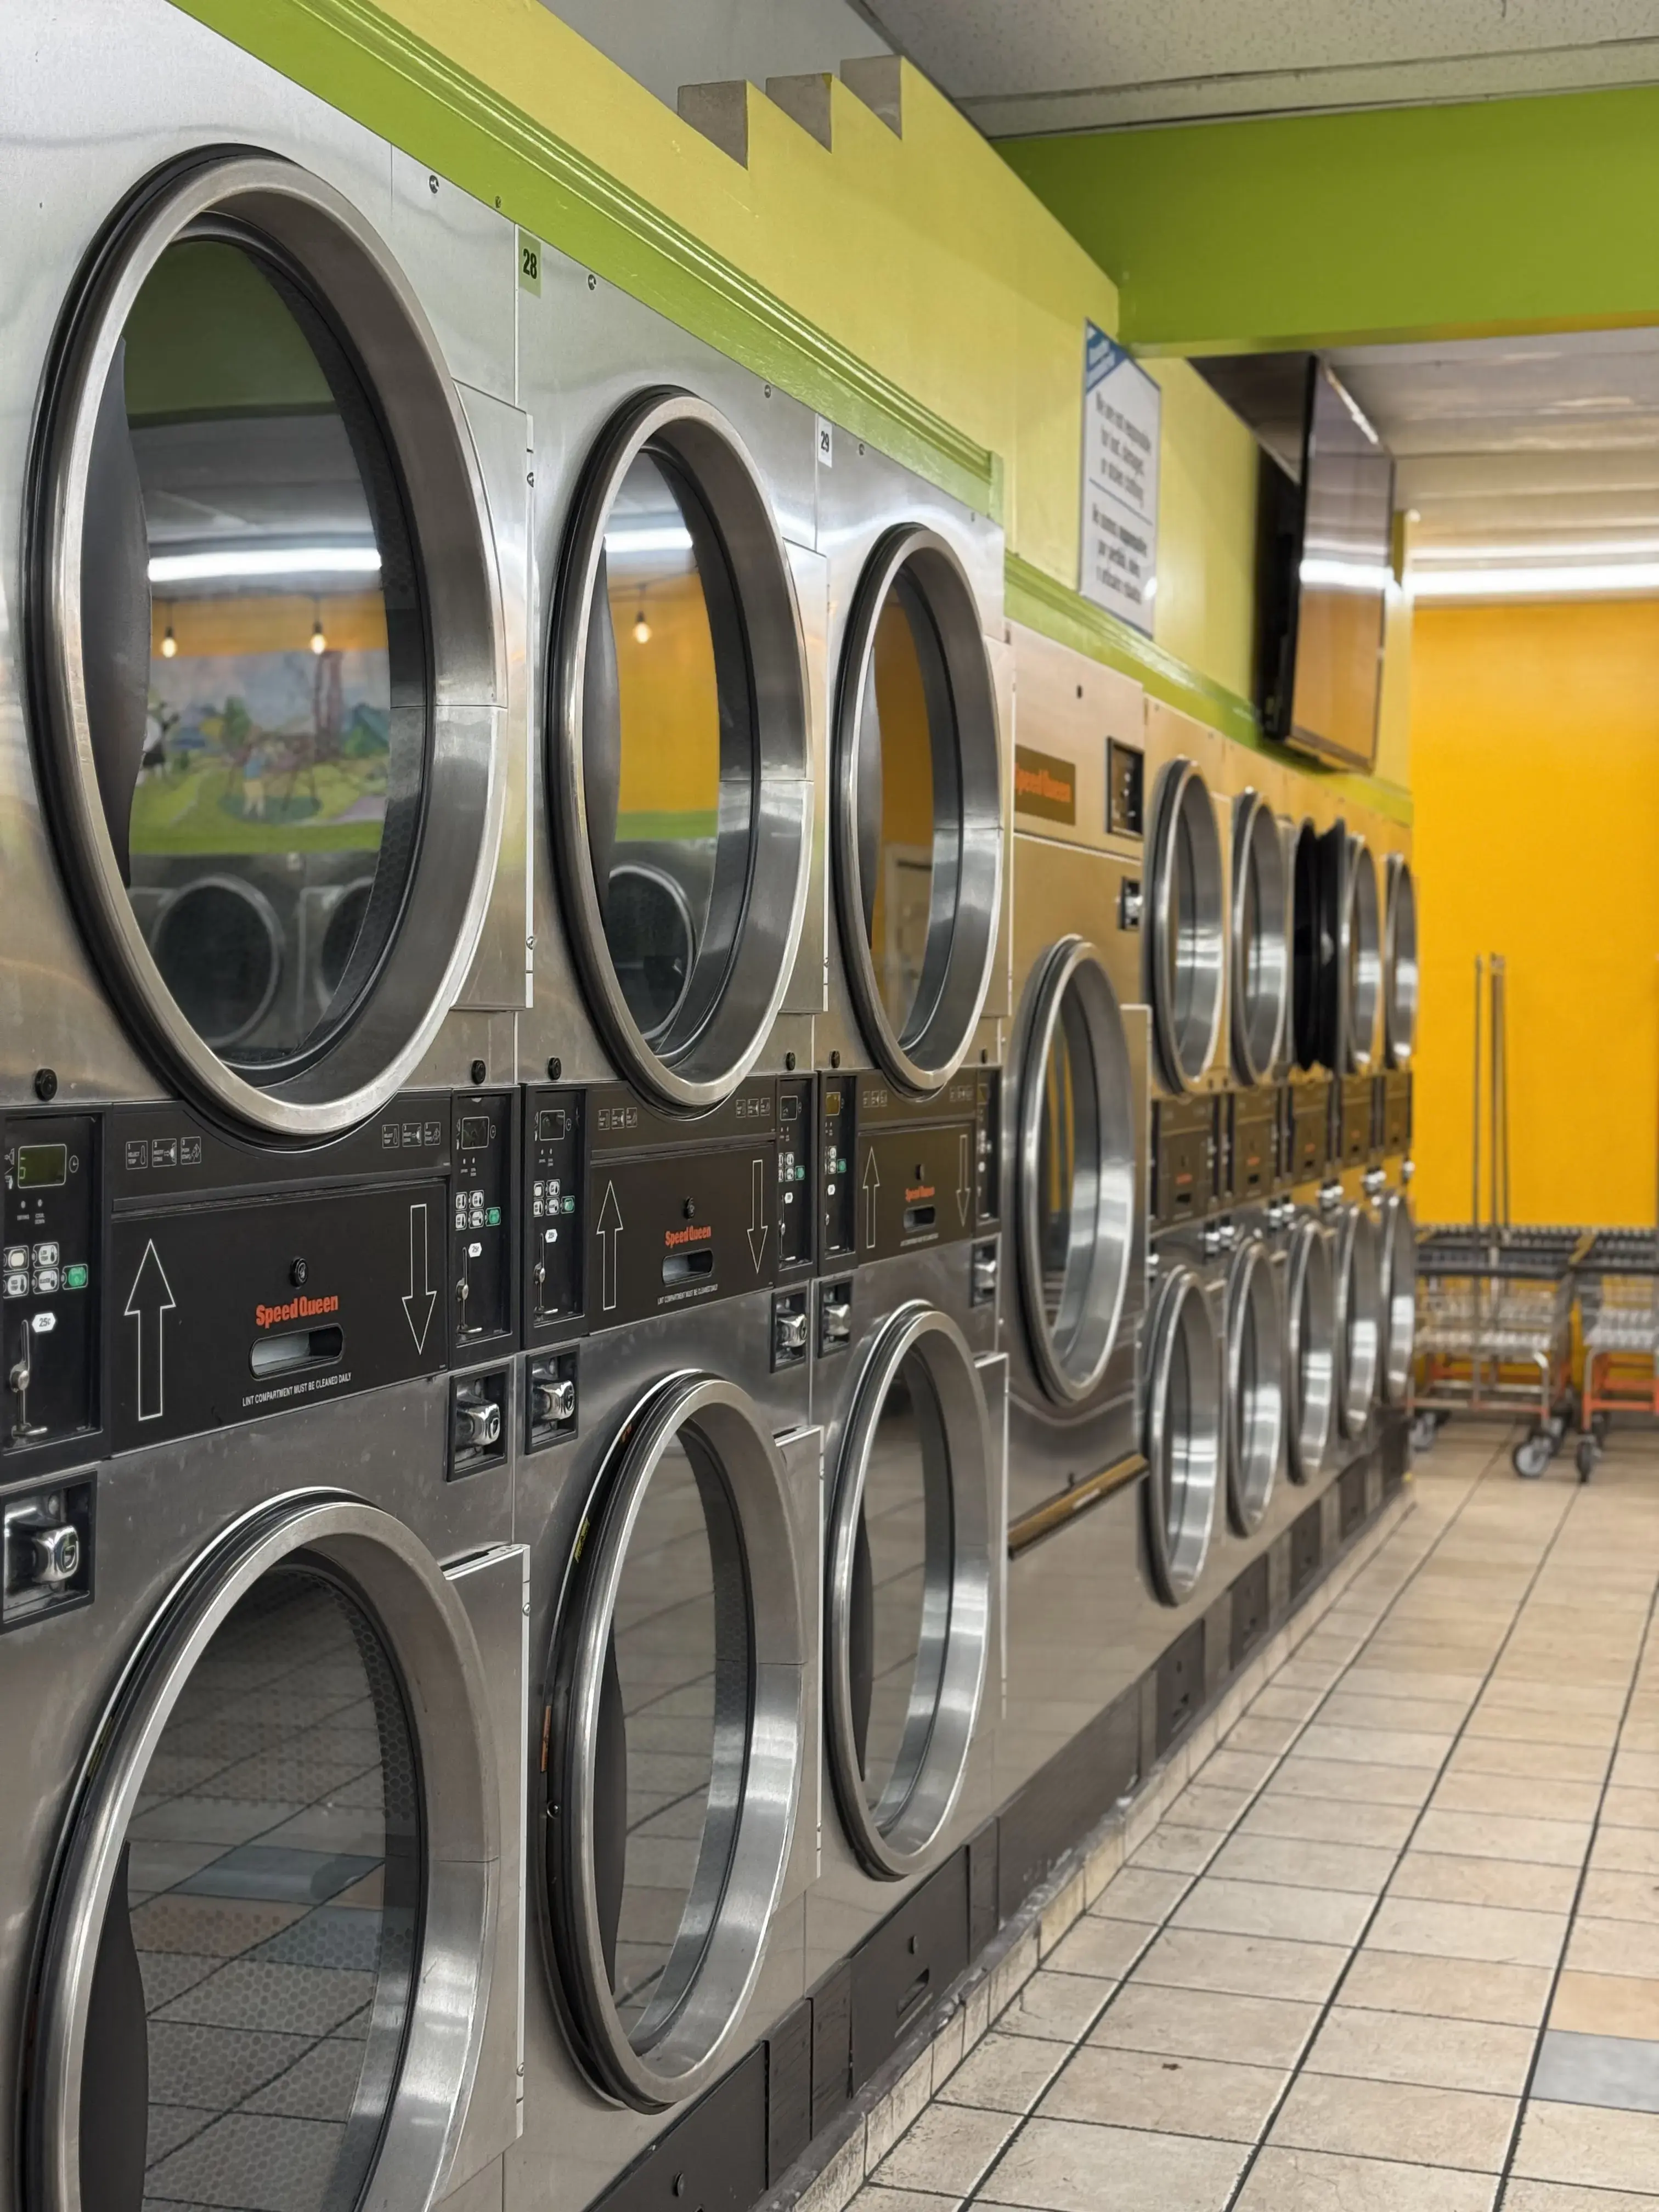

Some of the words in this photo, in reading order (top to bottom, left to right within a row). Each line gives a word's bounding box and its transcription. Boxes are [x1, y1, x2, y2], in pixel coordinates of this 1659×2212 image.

[523, 248, 537, 279] 28
[821, 431, 830, 453] 29
[665, 1227, 689, 1249] Speed
[689, 1226, 712, 1241] Queen
[256, 1297, 298, 1329] Speed
[298, 1295, 338, 1317] Queen
[242, 1395, 255, 1407] LINT
[255, 1386, 293, 1404] COMPARTMENT
[294, 1383, 307, 1393] MUST
[308, 1381, 315, 1391] BE
[316, 1375, 338, 1389] CLEANED
[338, 1372, 352, 1384] DAILY
